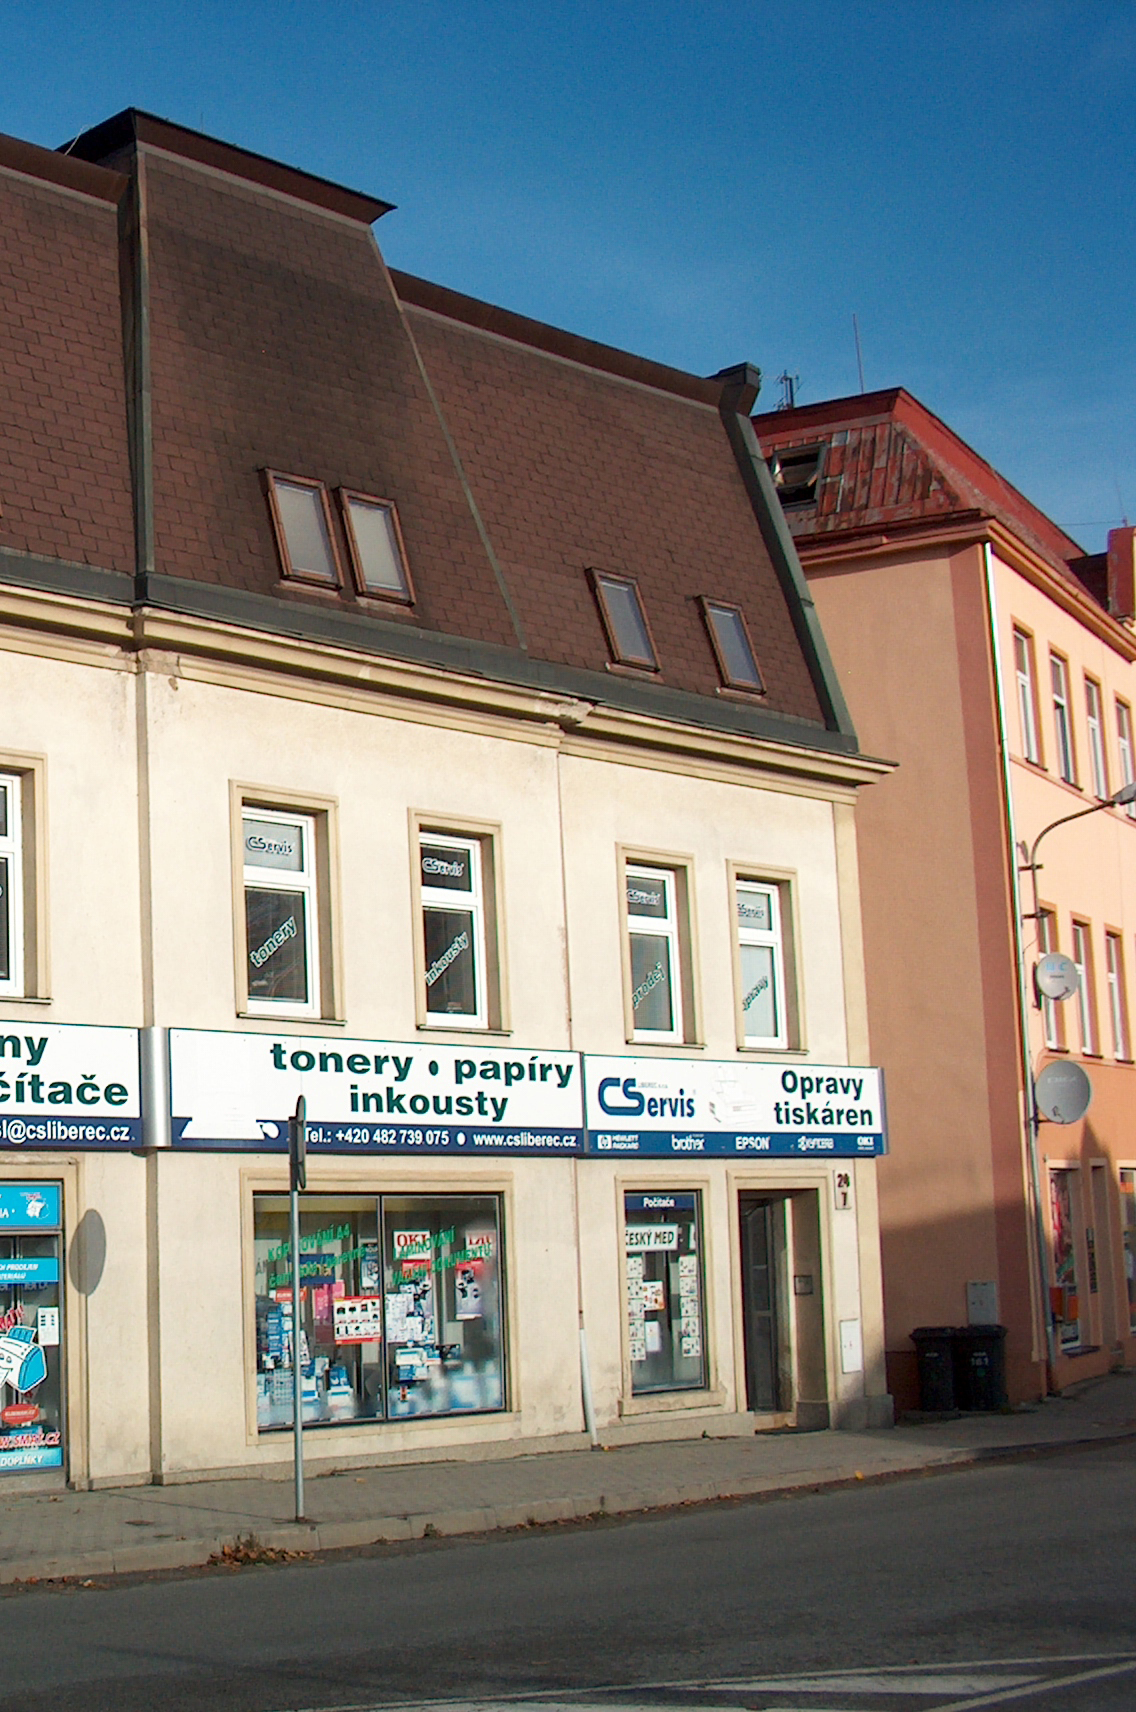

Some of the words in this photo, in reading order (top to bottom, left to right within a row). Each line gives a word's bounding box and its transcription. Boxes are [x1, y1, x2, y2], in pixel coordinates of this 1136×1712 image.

[250, 916, 297, 968] tonery
[424, 931, 469, 986] inkousty
[632, 961, 666, 1010] prodej
[270, 1043, 414, 1081] tonery
[454, 1056, 574, 1088] papíry
[781, 1070, 864, 1101] Opravy
[350, 1084, 509, 1122] inkousty
[774, 1100, 873, 1126] tiskáren
[335, 1129, 370, 1144] +420
[373, 1129, 397, 1145] 482
[399, 1130, 423, 1146] 739
[426, 1130, 450, 1146] 075
[473, 1130, 577, 1148] www.csliberec.cz
[671, 1134, 705, 1151] brother
[735, 1136, 771, 1150] EPSON
[336, 1223, 351, 1240] A4
[654, 1232, 674, 1245] MED
[0, 1454, 44, 1468] DOPLŇKY
